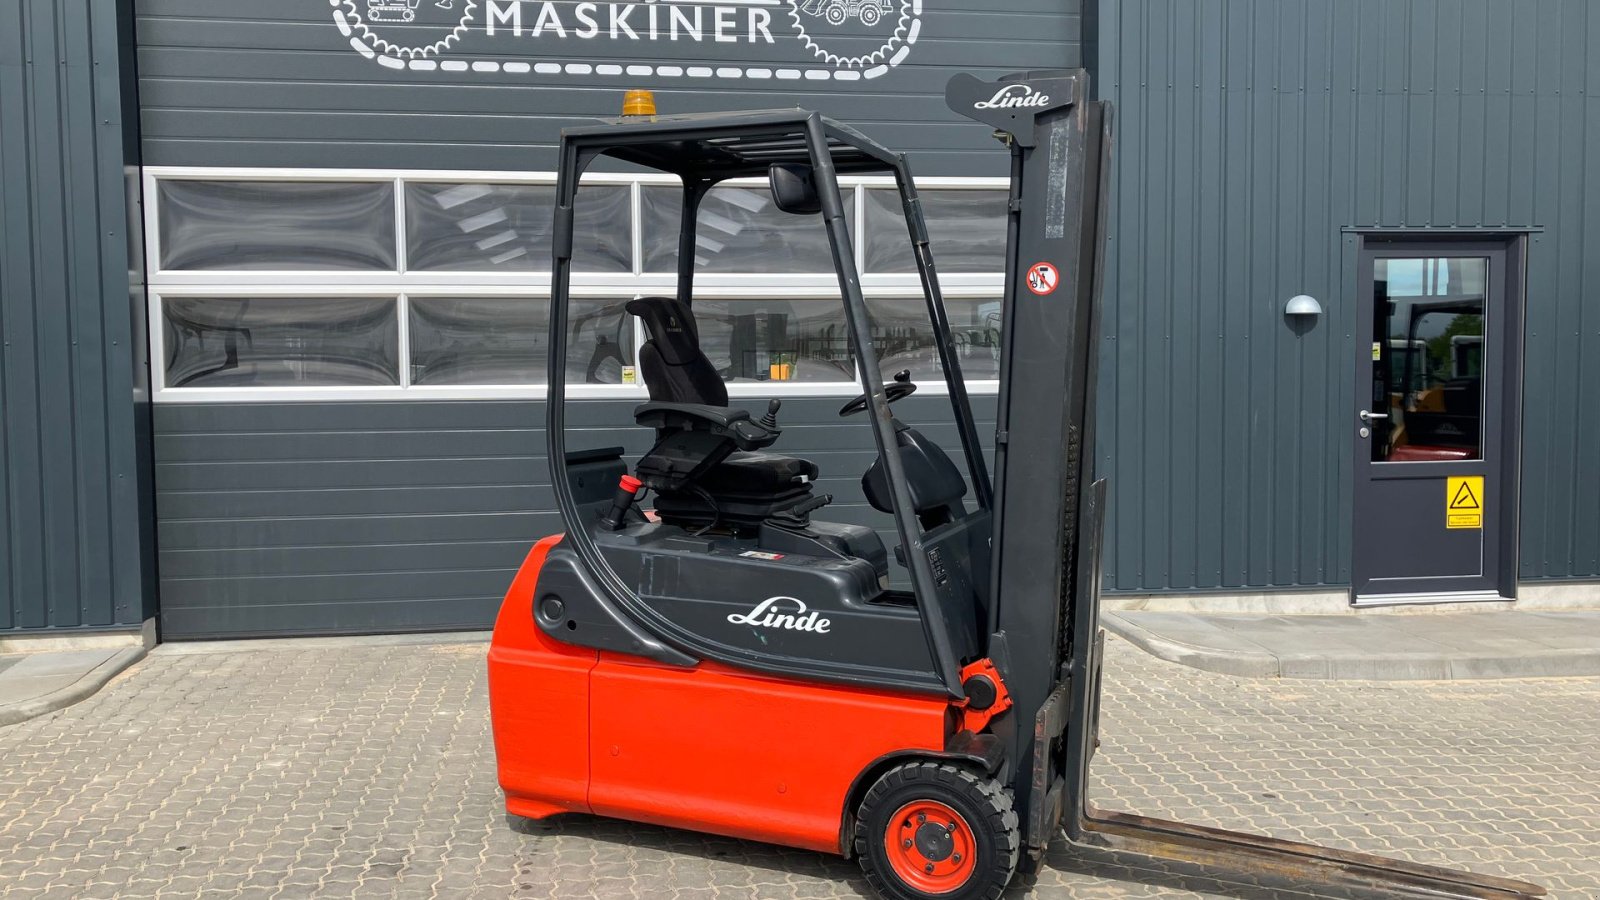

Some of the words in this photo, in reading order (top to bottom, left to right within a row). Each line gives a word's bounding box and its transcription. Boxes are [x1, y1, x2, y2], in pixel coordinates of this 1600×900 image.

[485, 0, 775, 43] MASKINER
[973, 84, 1050, 109] Linde
[726, 596, 831, 634] Linde
